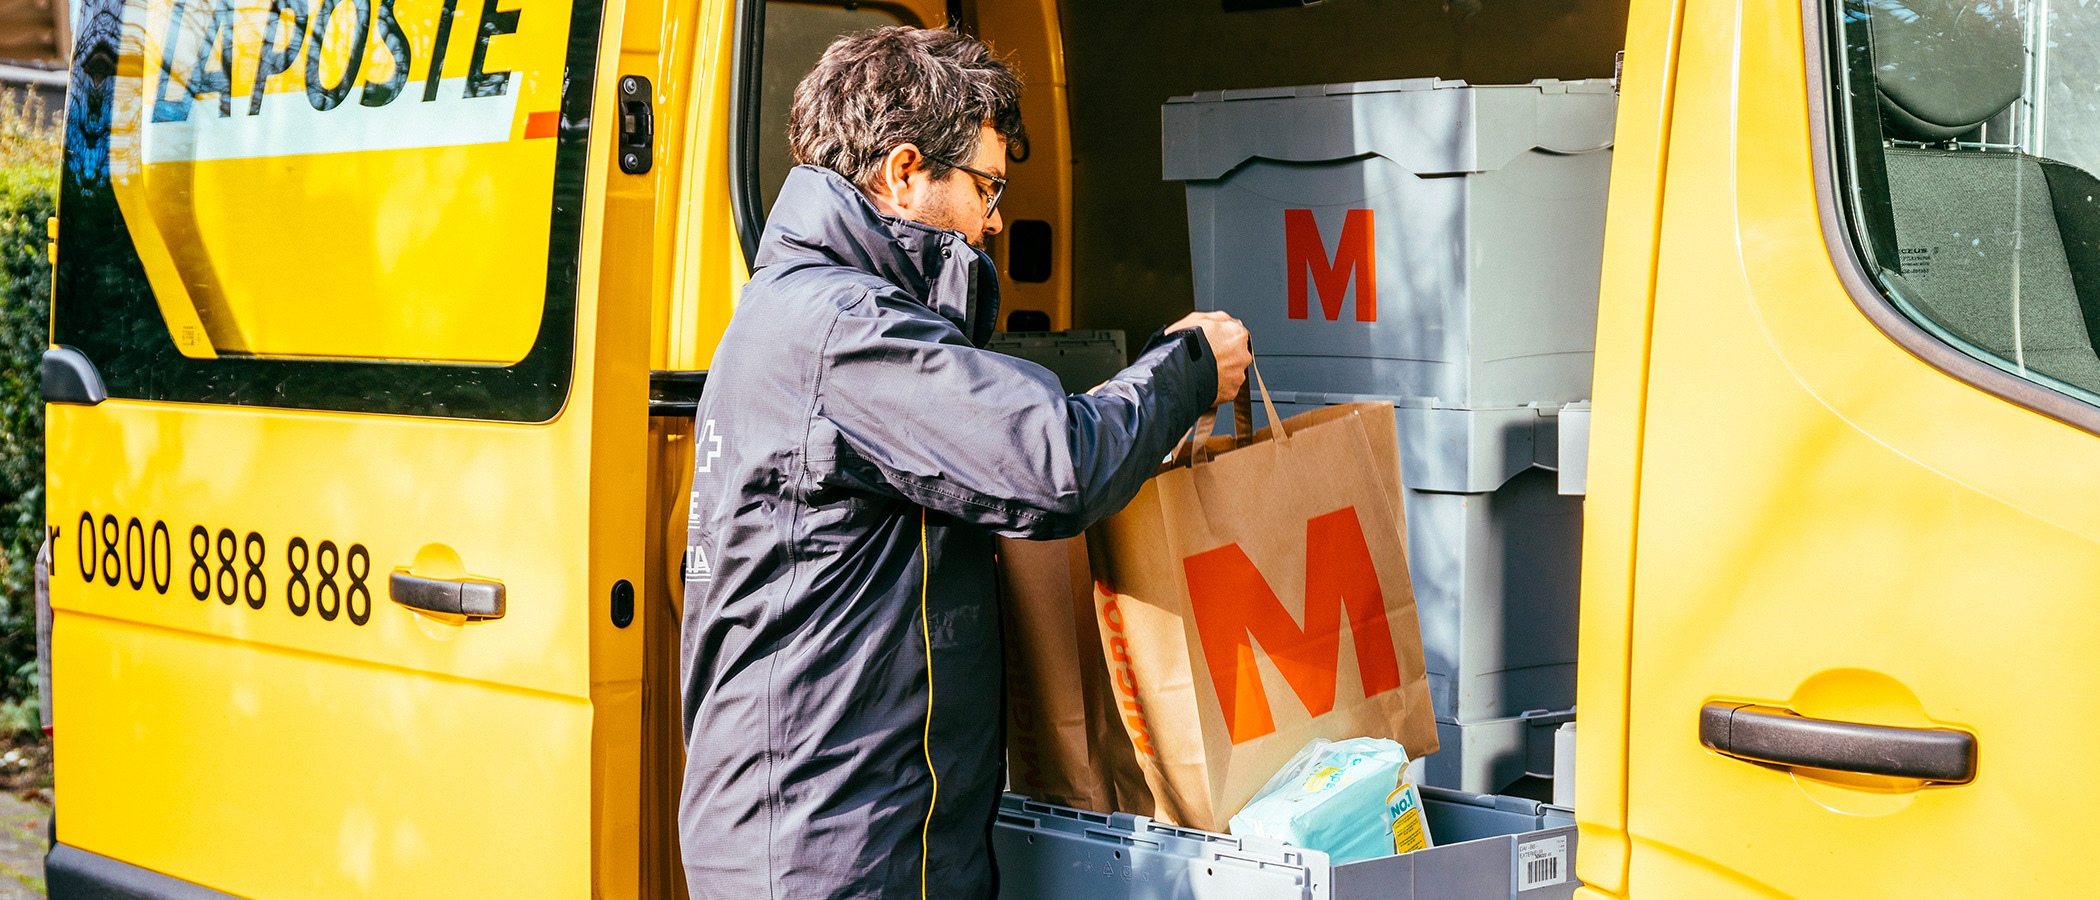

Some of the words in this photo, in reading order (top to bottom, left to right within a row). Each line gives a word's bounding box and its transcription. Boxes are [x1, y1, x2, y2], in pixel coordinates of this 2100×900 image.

[1284, 208, 1377, 322] M
[79, 511, 171, 595] 0800
[190, 524, 267, 610] 888
[287, 536, 372, 627] 888
[1183, 505, 1401, 746] M
[1096, 571, 1155, 757] MIGROS
[1390, 789, 1414, 819] NO.1
